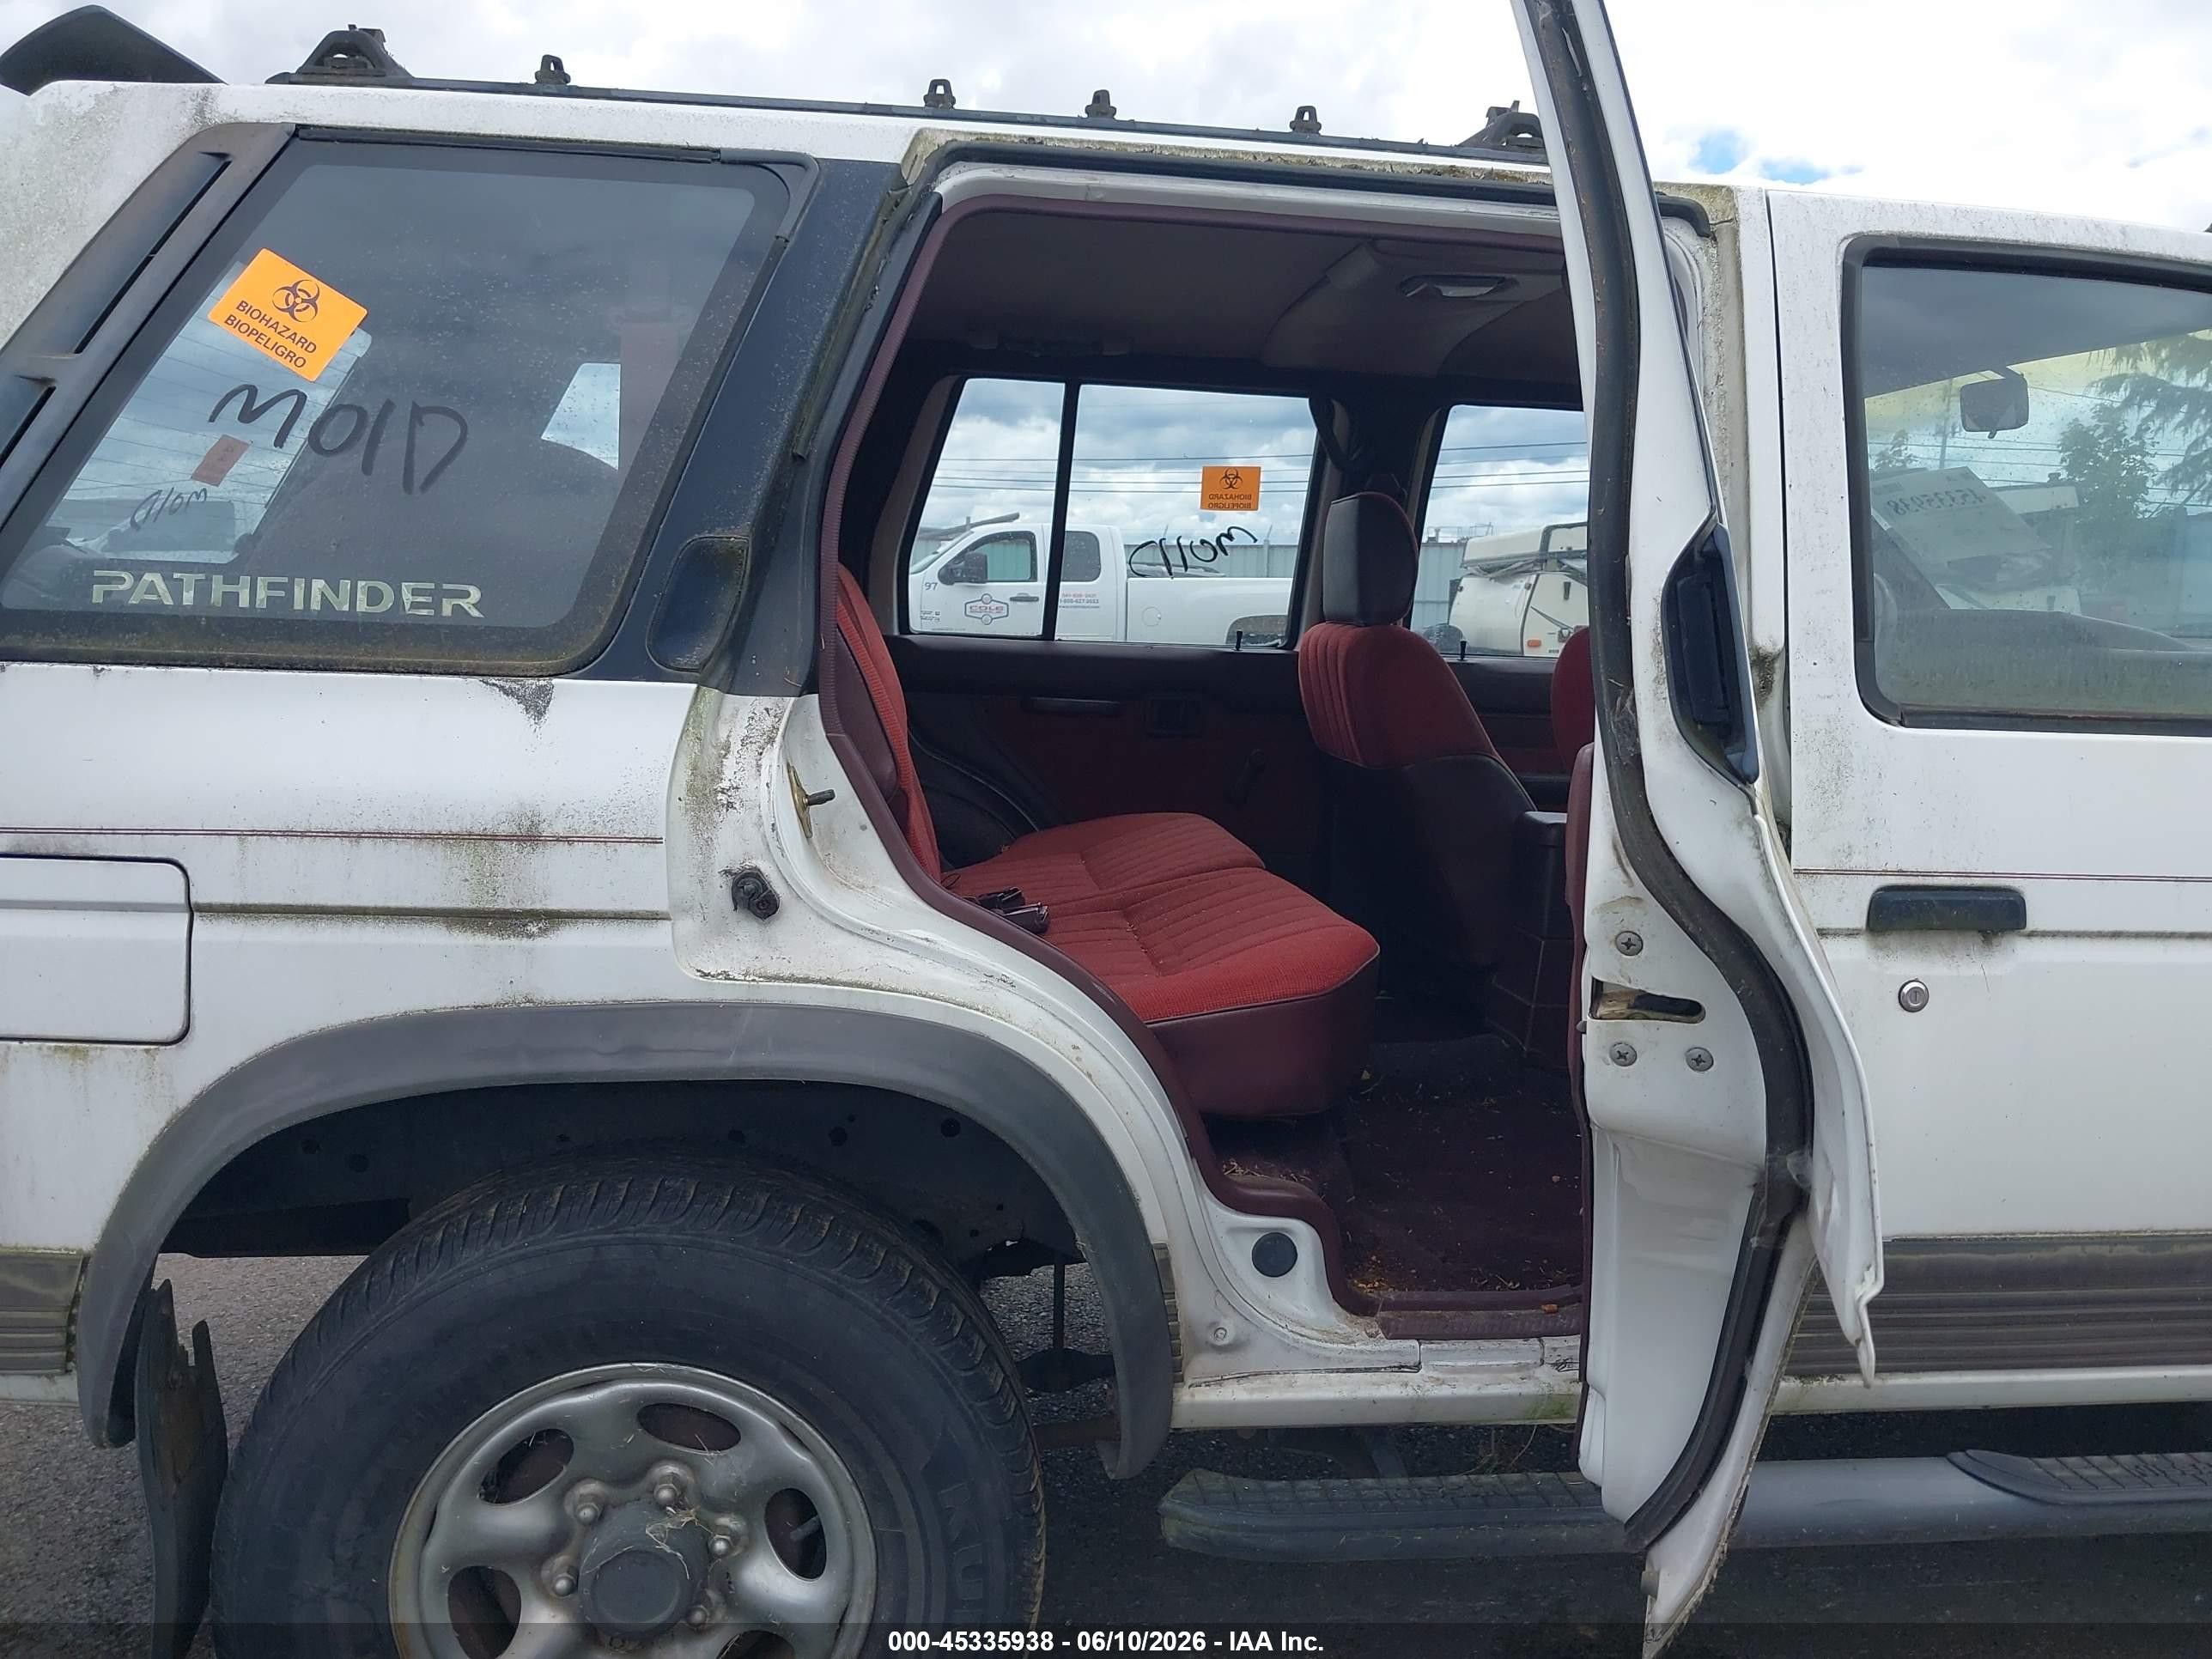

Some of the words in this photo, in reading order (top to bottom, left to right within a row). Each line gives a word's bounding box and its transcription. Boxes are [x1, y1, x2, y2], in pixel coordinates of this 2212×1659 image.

[224, 314, 307, 368] BIOPELIGRO
[235, 301, 317, 354] BIOHAZARD
[92, 570, 484, 618] PATHFINDER
[925, 582, 939, 591] 97
